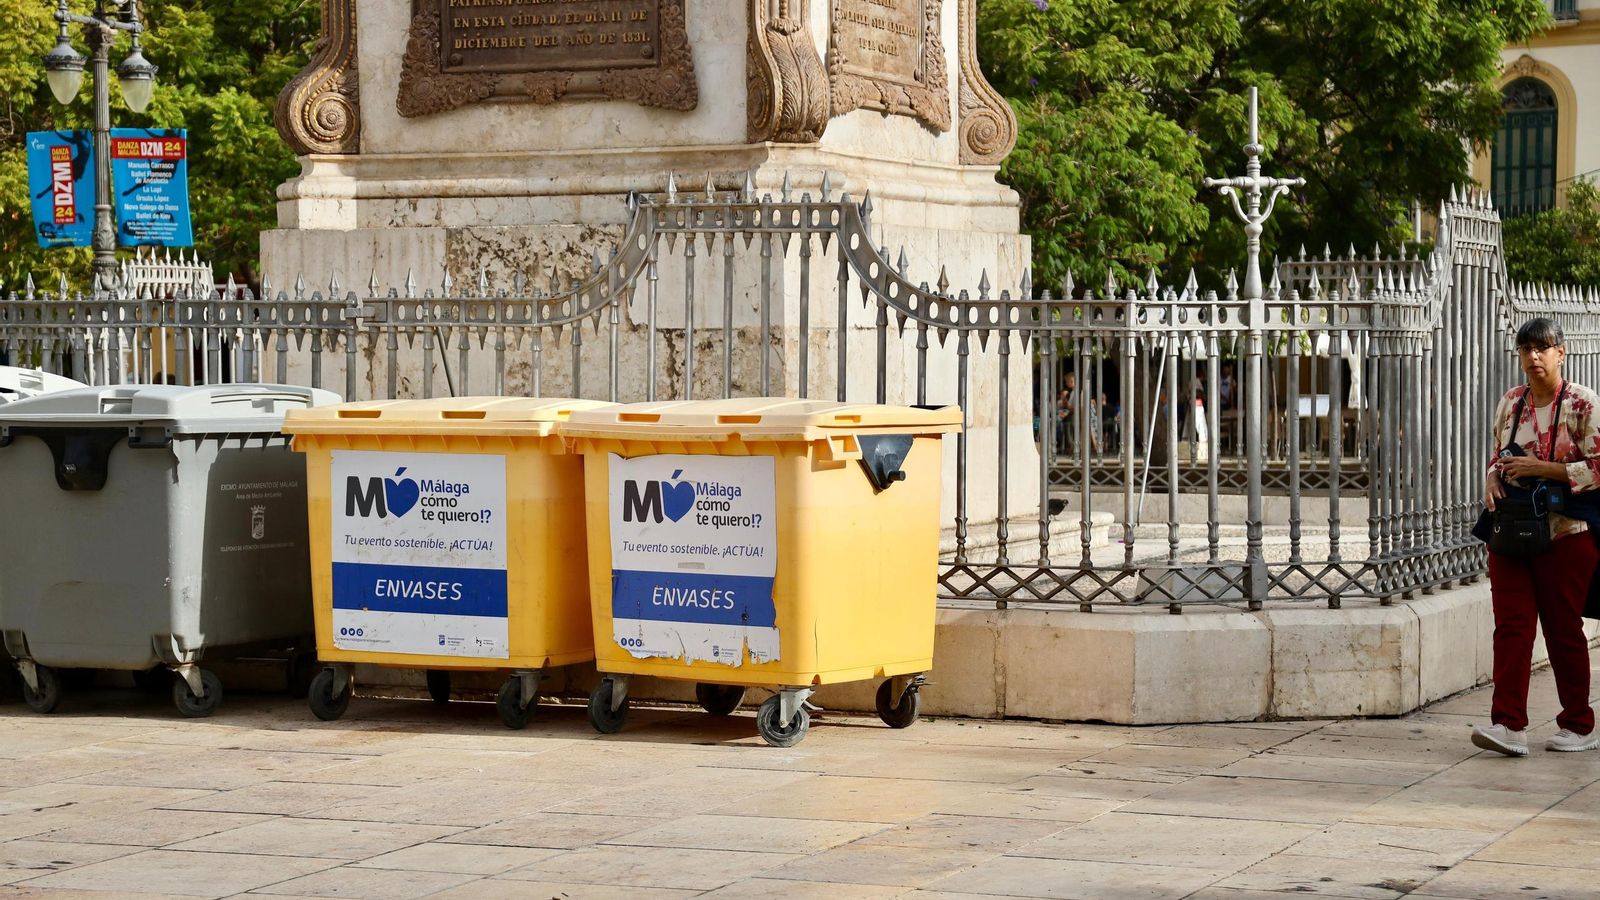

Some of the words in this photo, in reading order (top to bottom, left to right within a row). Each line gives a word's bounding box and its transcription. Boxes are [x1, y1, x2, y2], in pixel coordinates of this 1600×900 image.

[454, 18, 469, 28] EN
[474, 16, 505, 27] ESTA
[565, 12, 582, 24] EL
[631, 9, 647, 22] DE
[534, 35, 558, 47] DEL
[566, 29, 592, 46] AÑO
[600, 33, 615, 44] DE
[117, 141, 138, 149] DANZA
[140, 141, 163, 156] DZM
[164, 141, 181, 151] 24
[53, 162, 73, 206] DZM
[154, 194, 169, 202] López
[56, 207, 73, 217] 24
[421, 480, 469, 496] Málaga
[697, 482, 741, 500] Málaga
[421, 494, 457, 507] cómo
[697, 497, 730, 511] cómo
[421, 508, 435, 521] te
[696, 513, 709, 525] te
[345, 535, 357, 545] Tu
[359, 537, 392, 547] evento
[449, 538, 493, 552] ¡ACTÚA!
[623, 541, 635, 551] Tu
[637, 543, 668, 553] evento
[722, 543, 764, 558] ¡ACTÚA!
[375, 579, 463, 600] ENVASES
[653, 587, 735, 609] ENVASES
